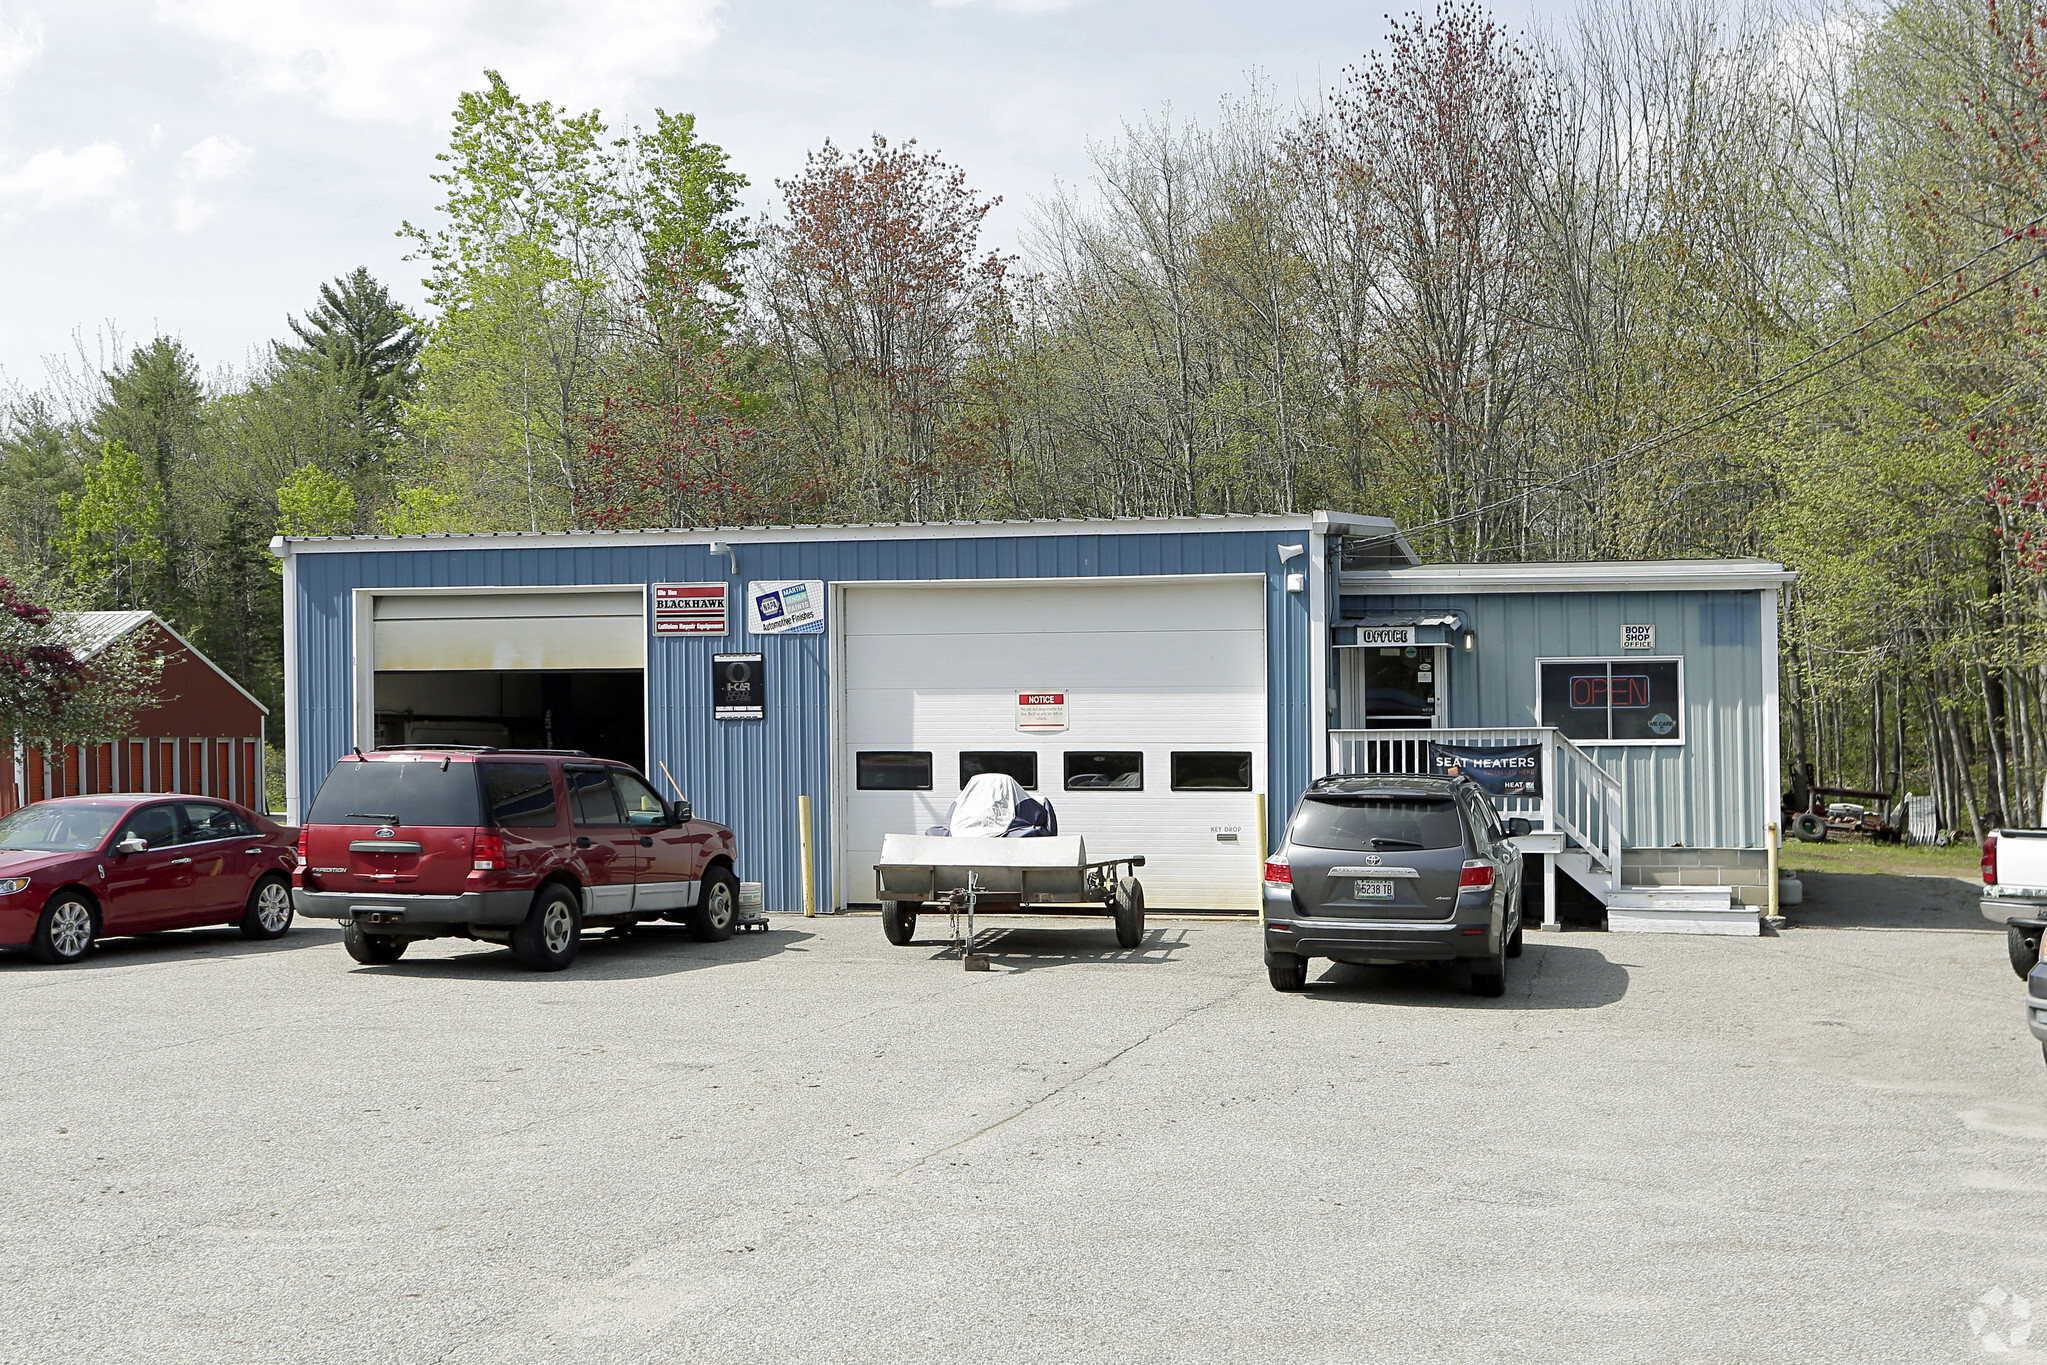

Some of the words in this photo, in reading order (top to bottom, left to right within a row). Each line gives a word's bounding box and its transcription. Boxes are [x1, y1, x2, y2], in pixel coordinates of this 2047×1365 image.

[783, 584, 805, 596] MARTIN
[656, 600, 724, 608] BLACKHAWK
[762, 600, 778, 612] NAPA
[787, 600, 810, 613] PAINTS
[679, 623, 696, 631] Repair
[696, 622, 724, 631] Equipment
[762, 616, 792, 632] Automotive
[791, 610, 815, 624] Finishes
[1625, 626, 1650, 634] BODY
[1364, 629, 1408, 643] OFFICE
[727, 682, 751, 691] I-CAR
[1573, 678, 1647, 705] OPEN
[1028, 696, 1054, 704] NOTICE
[1436, 757, 1468, 767] SEAT
[1473, 757, 1535, 768] HEATERS
[1361, 884, 1380, 894] 5238
